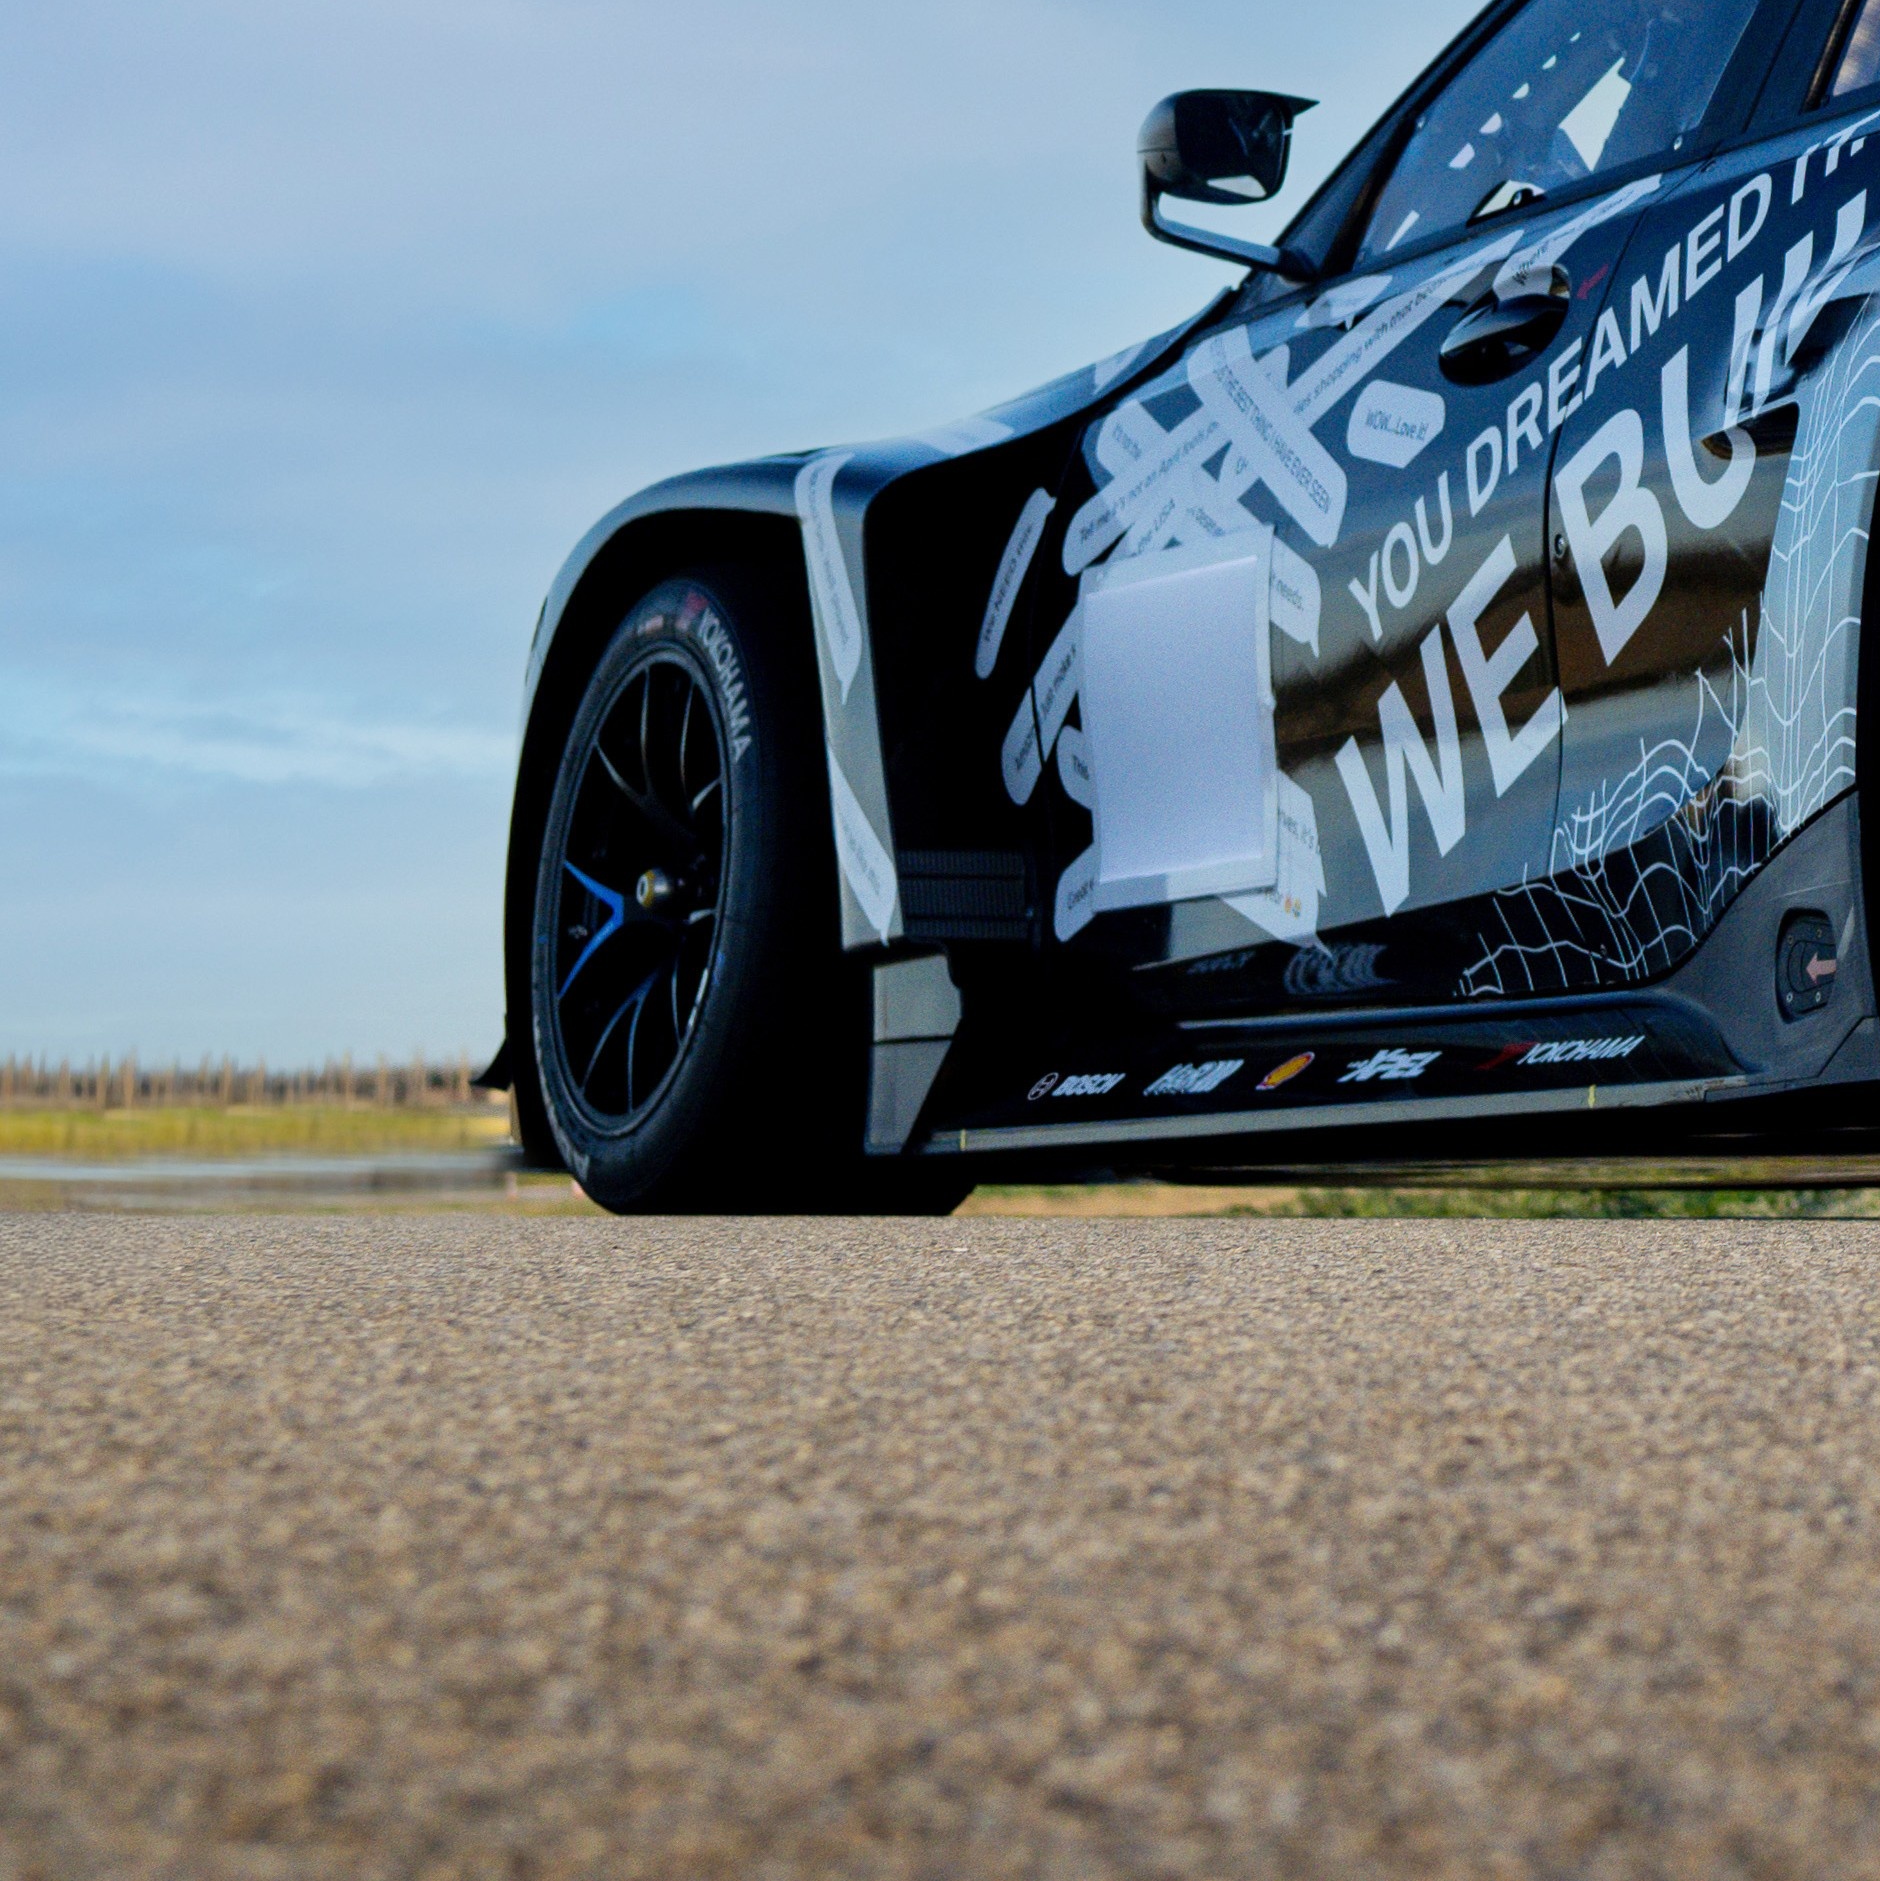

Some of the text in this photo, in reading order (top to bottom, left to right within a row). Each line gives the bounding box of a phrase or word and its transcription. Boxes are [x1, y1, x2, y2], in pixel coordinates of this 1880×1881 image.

[1348, 472, 1454, 643] YOU
[1466, 173, 1772, 519] DREAMED
[1308, 473, 1331, 517] SEEN
[698, 606, 753, 764] YOKOHAMA
[1334, 533, 1569, 918] WE
[1051, 1072, 1127, 1097] BOSCH
[1517, 1034, 1647, 1066] YOKOHAMA
